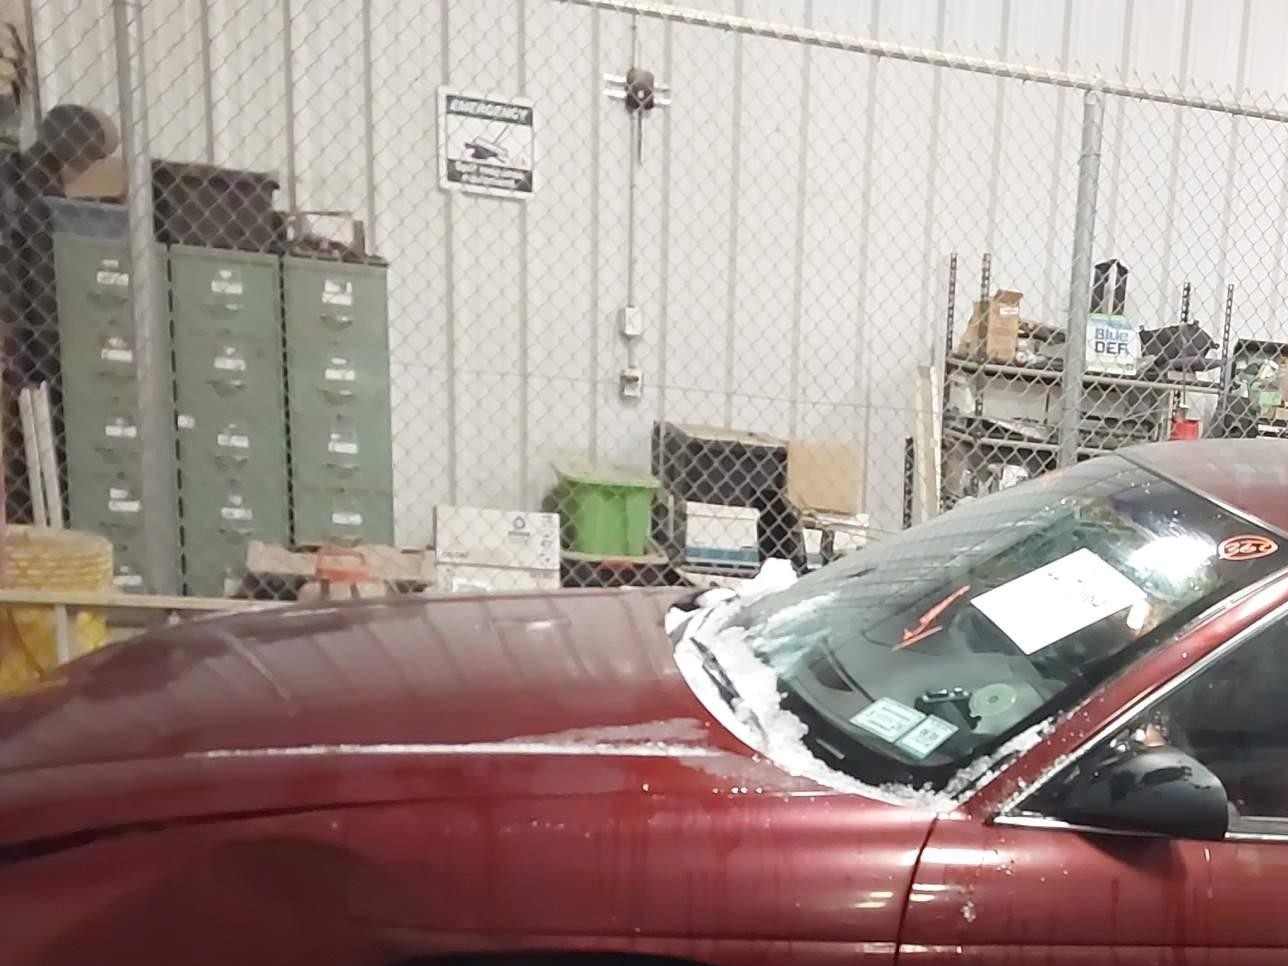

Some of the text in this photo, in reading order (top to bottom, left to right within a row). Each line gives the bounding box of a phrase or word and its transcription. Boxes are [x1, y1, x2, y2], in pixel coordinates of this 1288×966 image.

[449, 98, 529, 121] EMERGENCY
[1095, 328, 1129, 341] Blue
[1095, 341, 1129, 354] DEF
